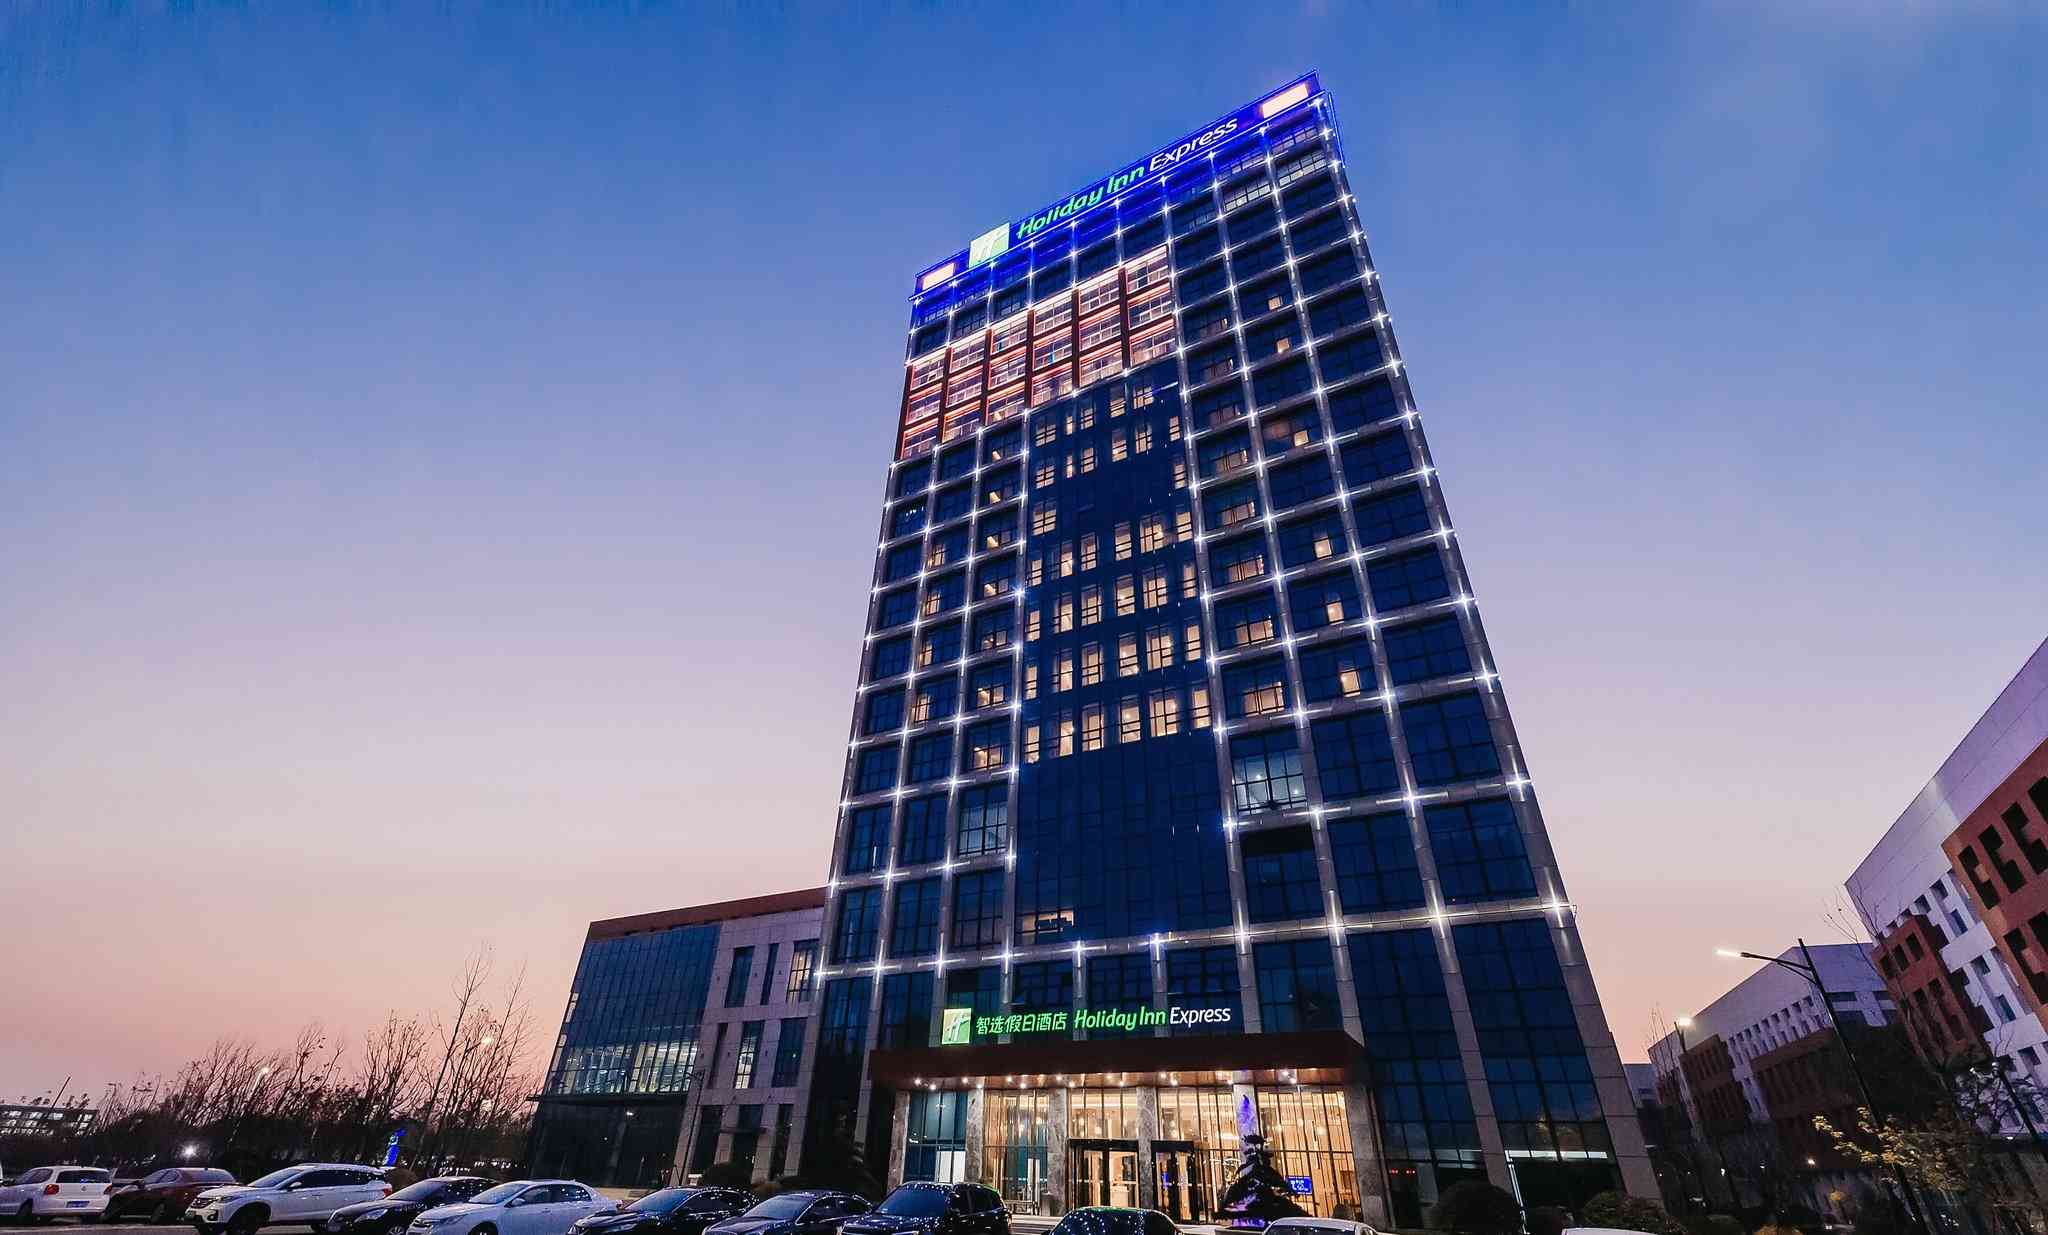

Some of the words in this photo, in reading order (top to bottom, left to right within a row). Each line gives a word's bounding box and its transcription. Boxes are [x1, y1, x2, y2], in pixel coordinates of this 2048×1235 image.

[1017, 187, 1104, 239] Holiday
[1106, 165, 1145, 195] Inn
[1150, 118, 1238, 171] Express
[976, 1012, 1068, 1035] 智选假日酒店
[1074, 1008, 1137, 1031] Holiday
[1139, 1005, 1166, 1026] Inn
[1169, 1006, 1232, 1028] Express
